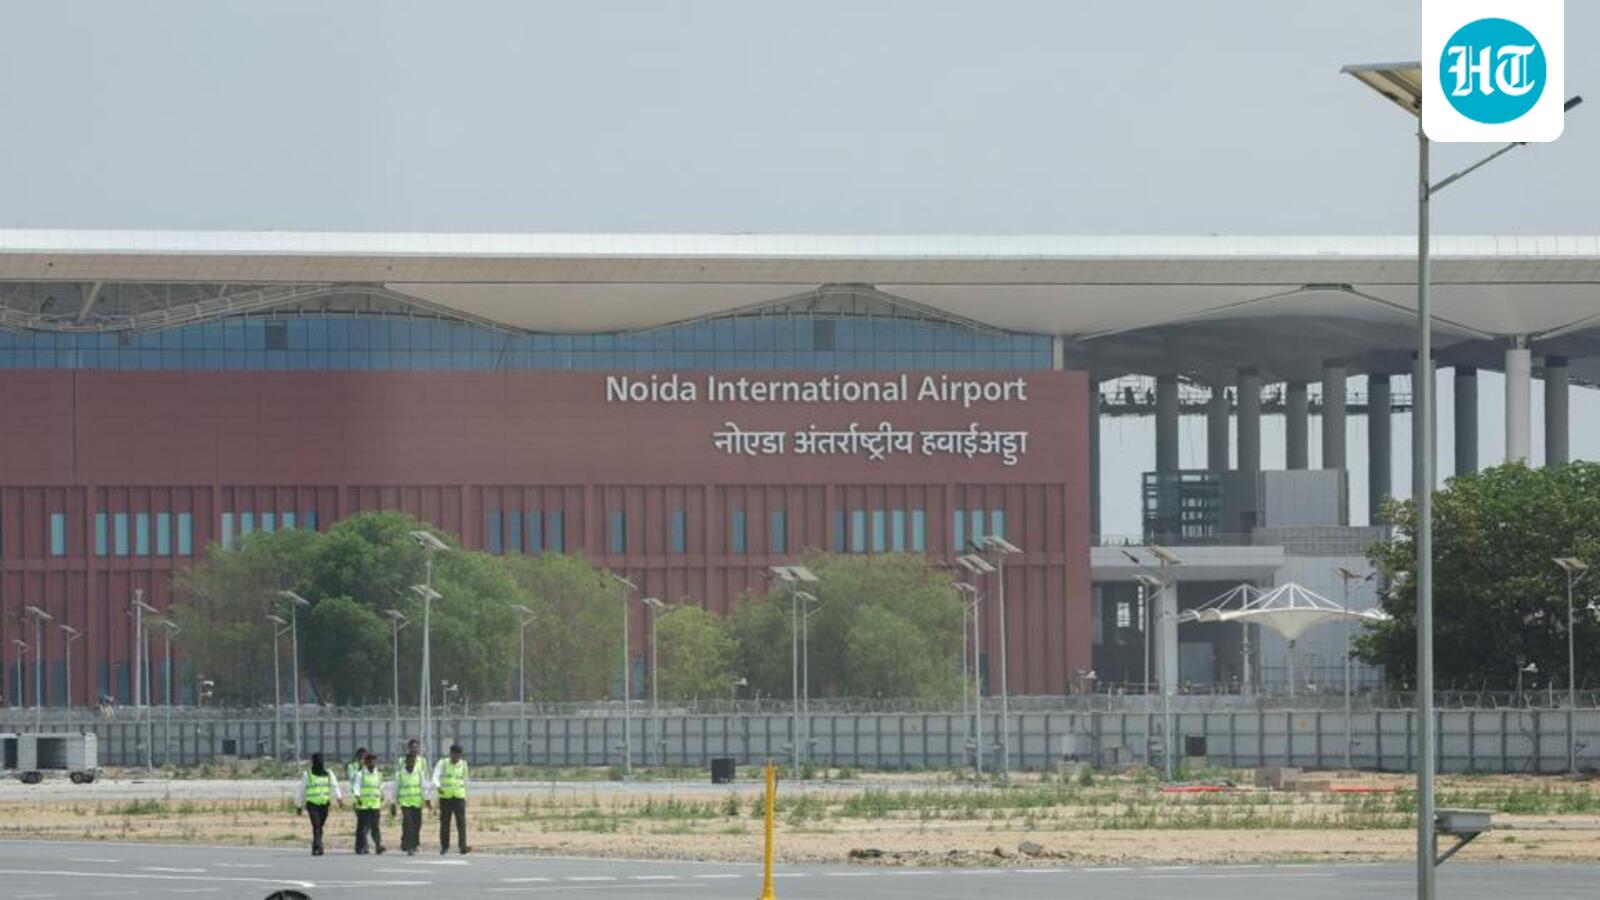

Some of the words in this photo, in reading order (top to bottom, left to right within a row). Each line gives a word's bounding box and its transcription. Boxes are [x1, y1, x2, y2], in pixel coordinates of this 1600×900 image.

[606, 375, 697, 402] Noida
[708, 374, 908, 402] International
[917, 374, 1028, 408] Airport
[713, 421, 786, 455] नोएडा
[793, 422, 913, 461] अंतर्राष्ट्रीय
[920, 423, 1028, 466] हवाईअड्डा
